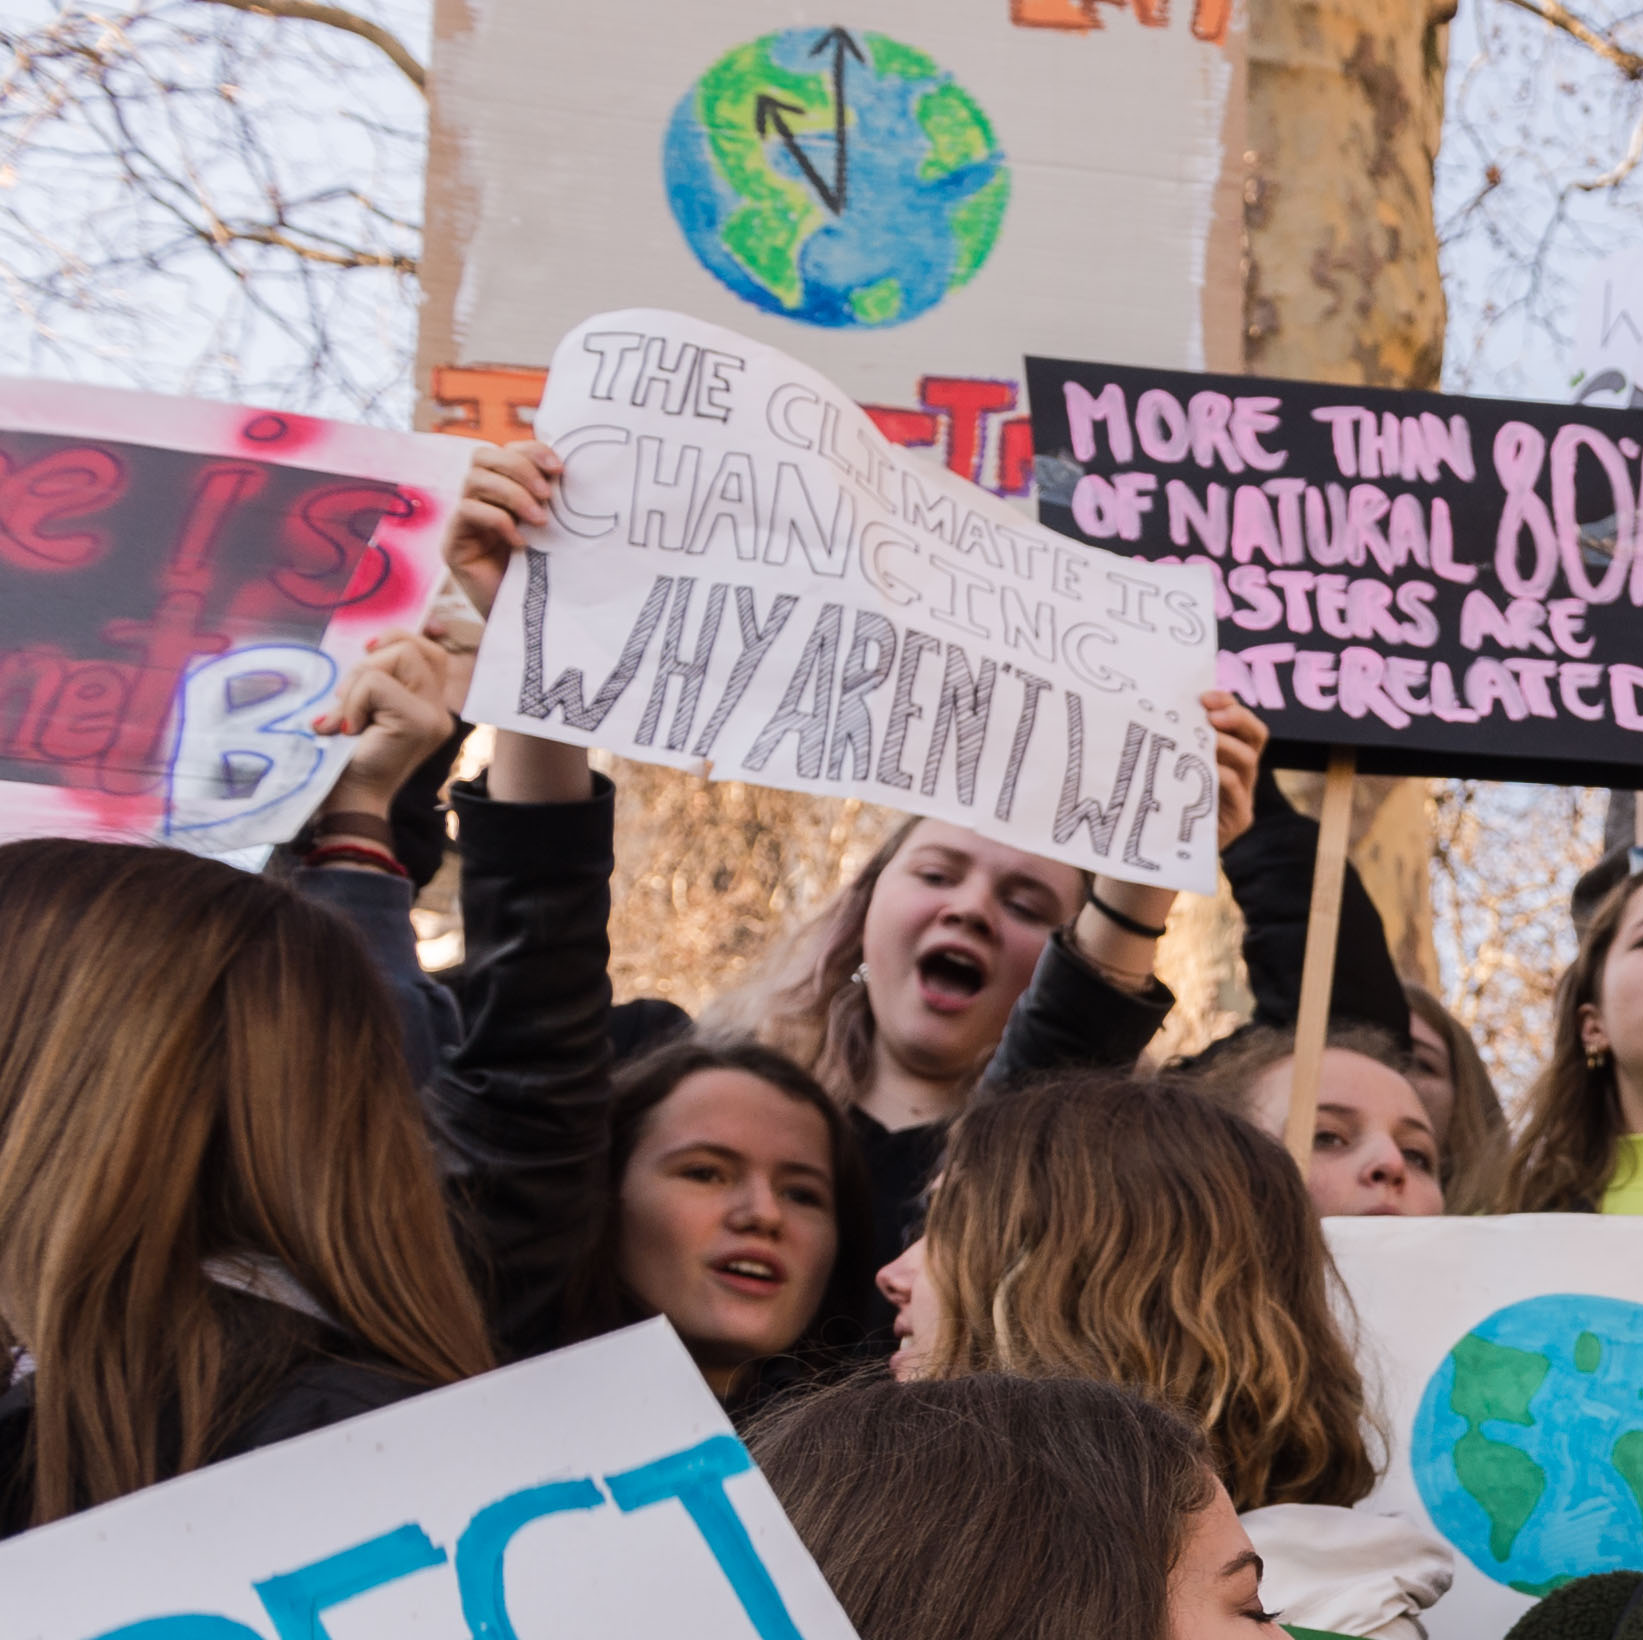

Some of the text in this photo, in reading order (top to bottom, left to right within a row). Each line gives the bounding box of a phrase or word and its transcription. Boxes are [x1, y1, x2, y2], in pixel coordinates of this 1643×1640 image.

[582, 331, 746, 425] THE
[765, 382, 1089, 603] CLIMATE
[1105, 571, 1207, 647] IS
[1062, 380, 1290, 475] MORE
[1070, 472, 1480, 585] OF NATURAL
[1460, 588, 1597, 659] ARE
[165, 642, 338, 836] B
[516, 546, 1217, 873] WHY AREN'T WE?
